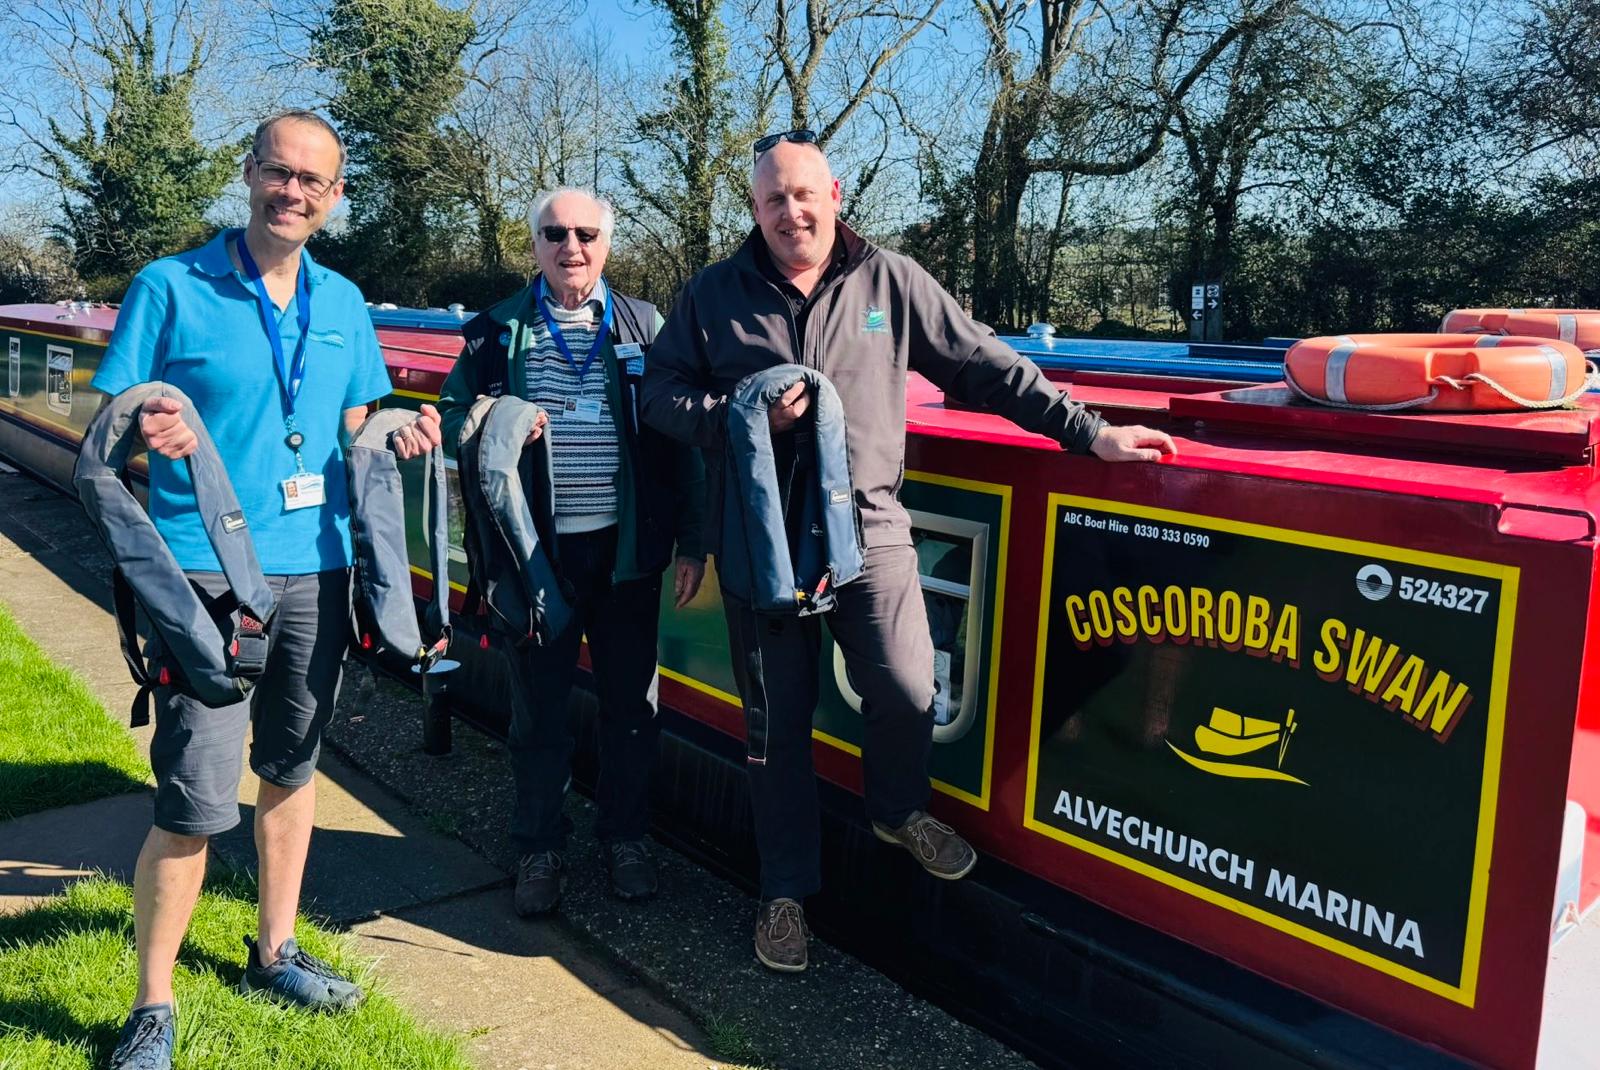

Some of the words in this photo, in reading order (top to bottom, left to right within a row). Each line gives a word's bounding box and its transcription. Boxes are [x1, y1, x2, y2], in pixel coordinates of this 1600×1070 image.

[1063, 511, 1082, 525] ABC
[1084, 515, 1106, 529] Boat
[1108, 518, 1129, 534] Hire
[1134, 523, 1159, 539] 0330
[1161, 528, 1181, 543] 333
[1183, 531, 1210, 548] 0590
[1398, 576, 1489, 614] 524327
[1065, 584, 1299, 660] COSCOROBA
[1312, 618, 1469, 738] SWAN
[1053, 790, 1254, 890] ALVECHURCH
[1264, 868, 1425, 958] MARINA
